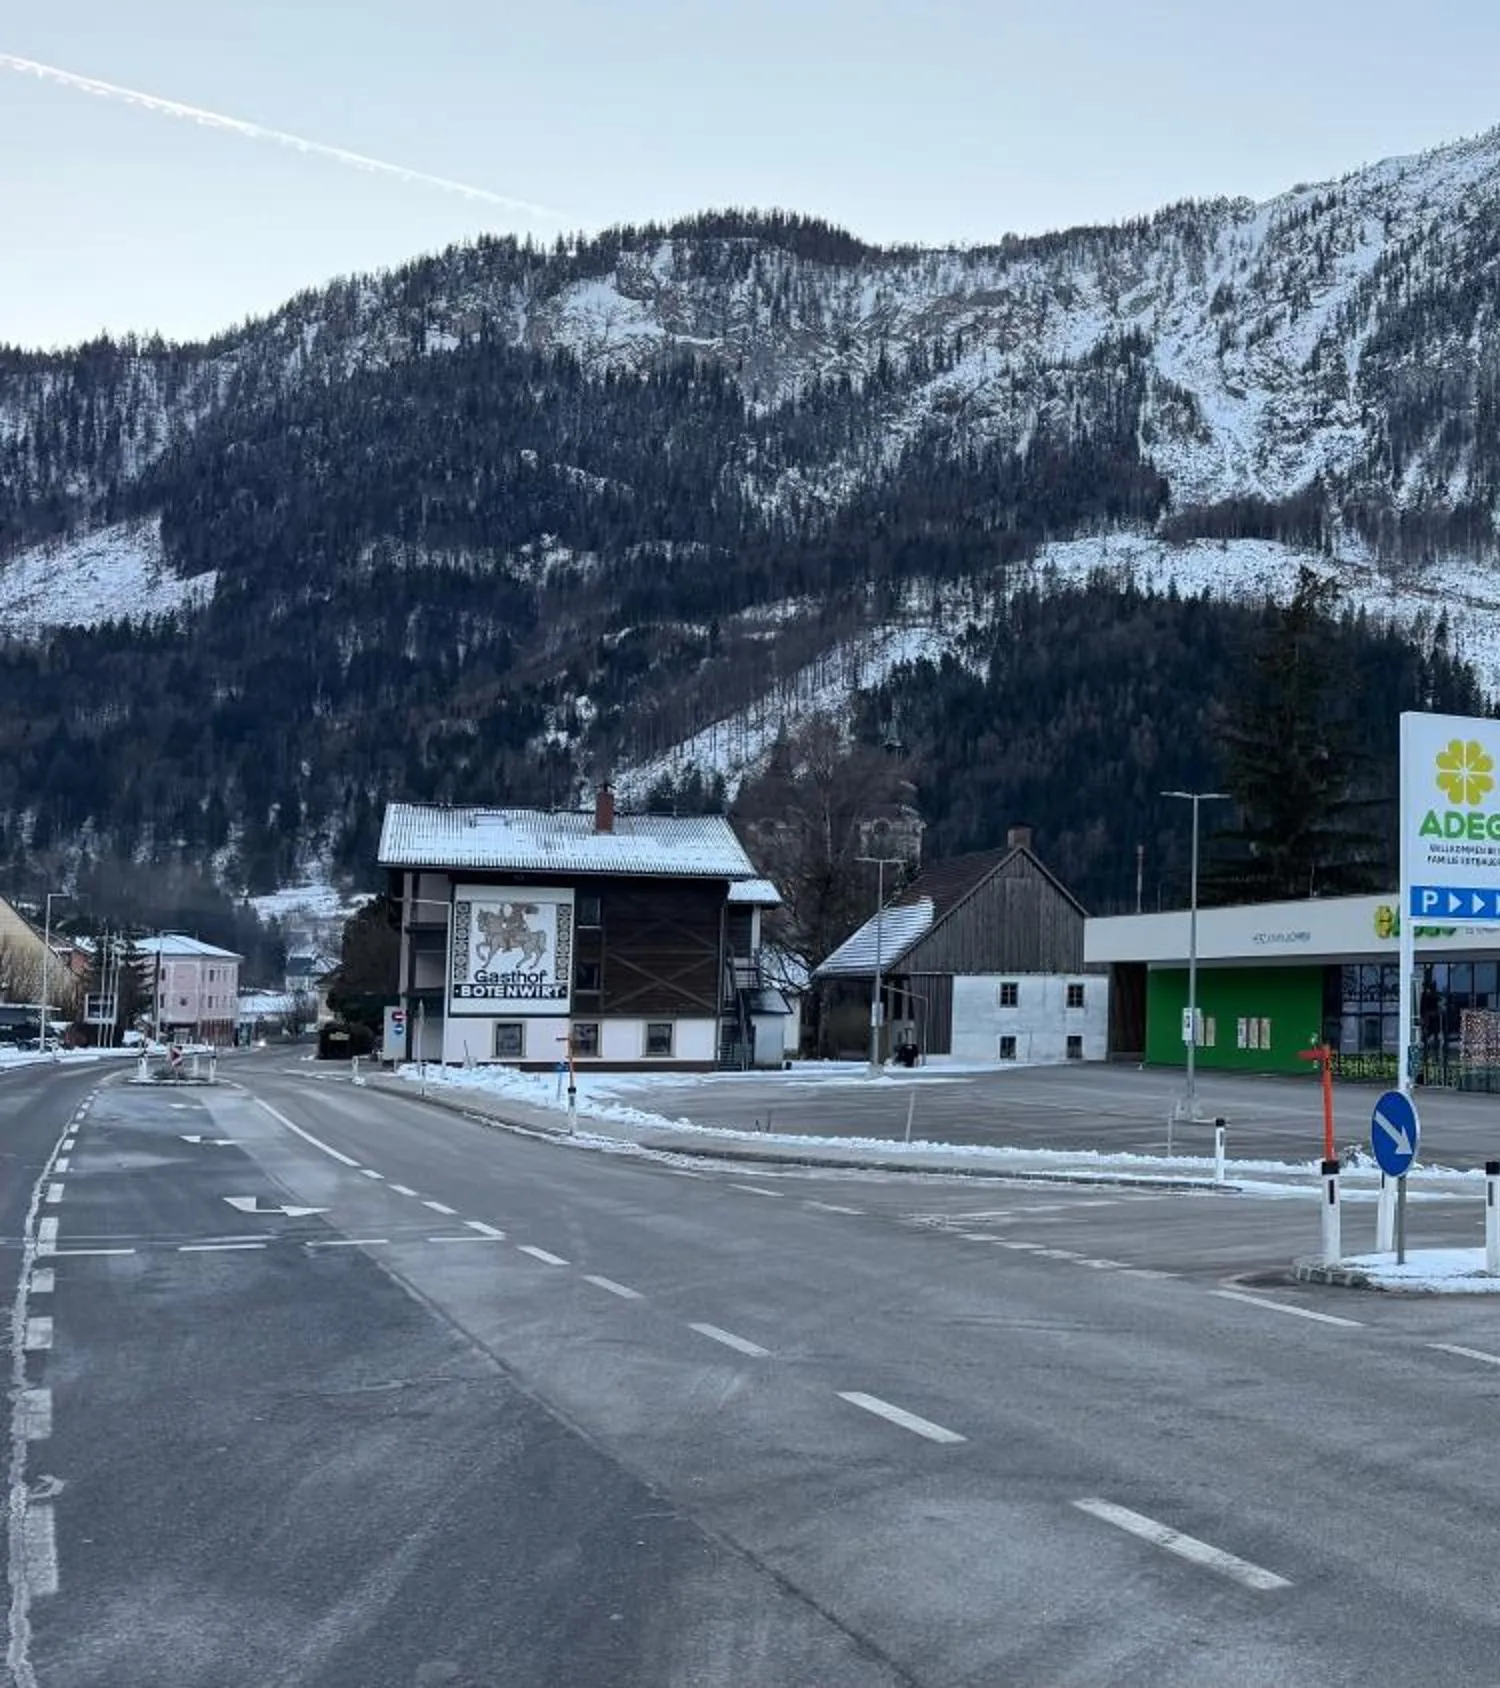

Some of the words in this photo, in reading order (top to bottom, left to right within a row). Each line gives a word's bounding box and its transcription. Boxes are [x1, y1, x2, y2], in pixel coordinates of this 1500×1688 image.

[1423, 890, 1438, 913] P
[474, 969, 548, 983] Gasthof
[461, 985, 560, 997] BOTENWIRT
